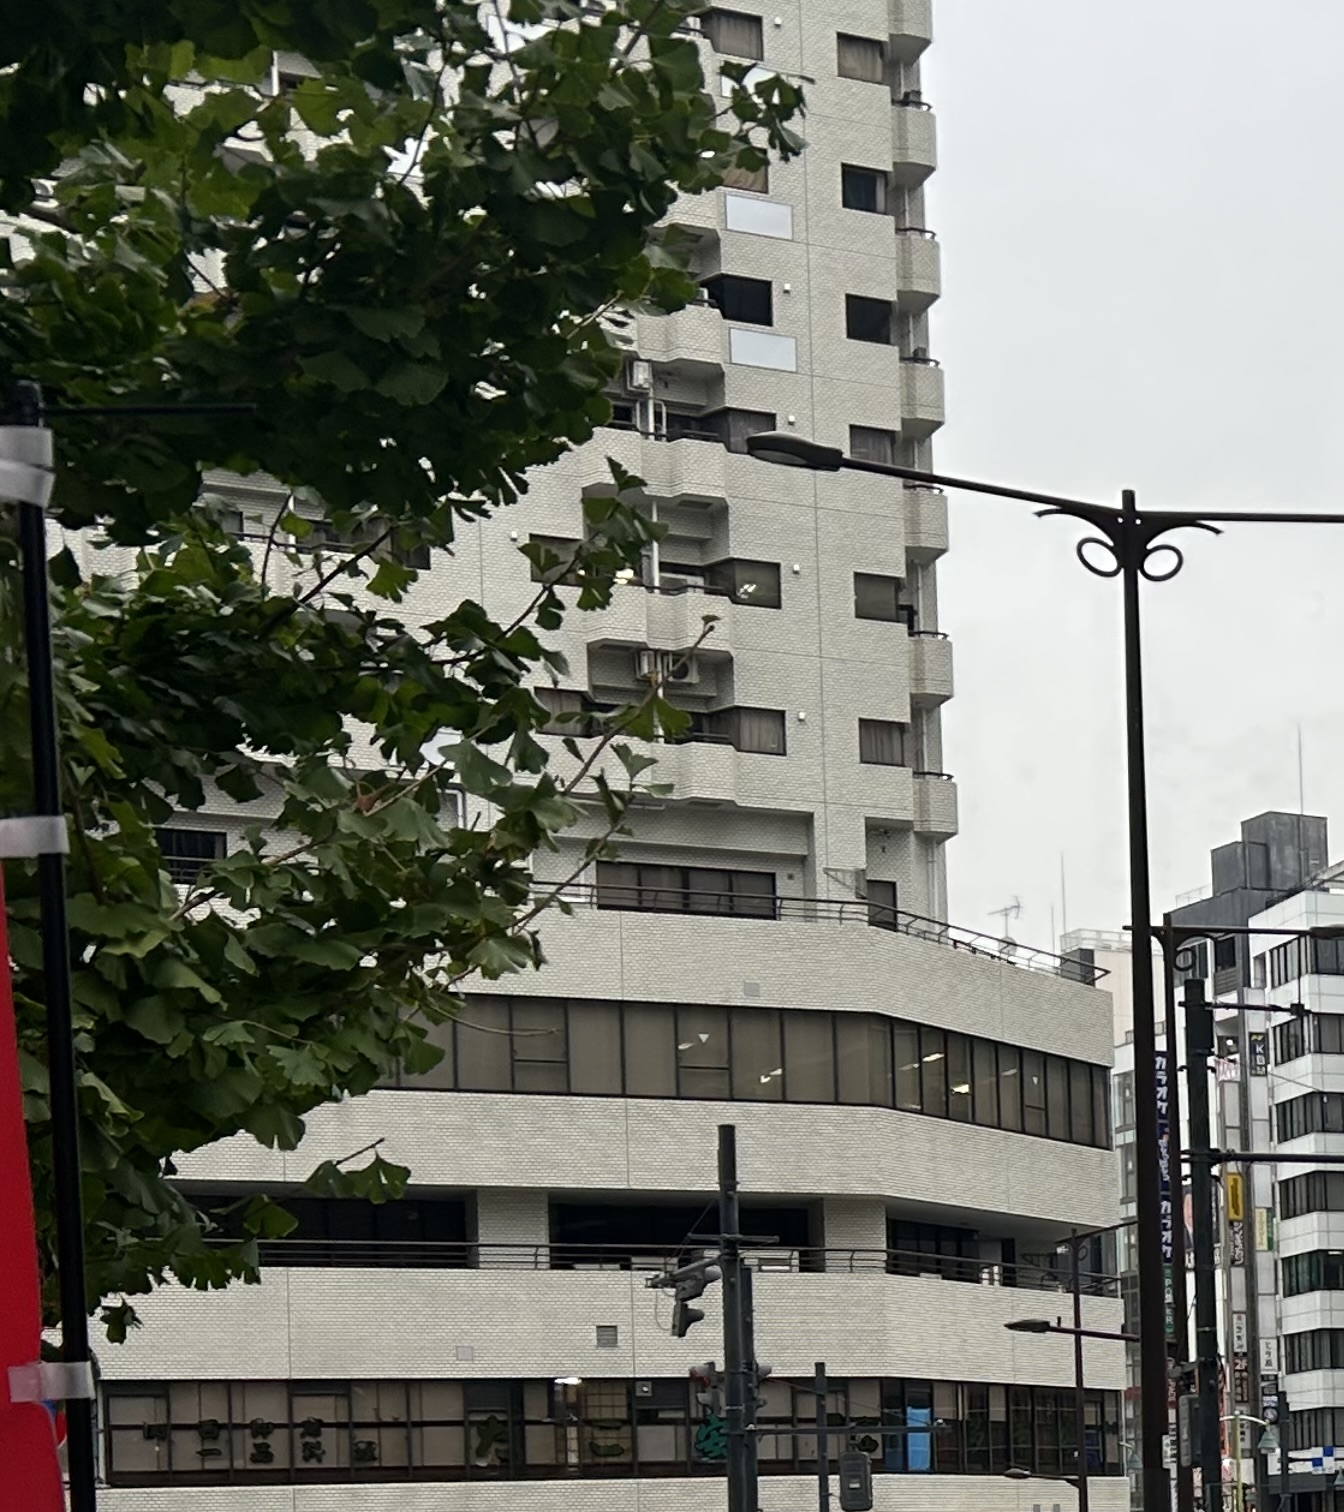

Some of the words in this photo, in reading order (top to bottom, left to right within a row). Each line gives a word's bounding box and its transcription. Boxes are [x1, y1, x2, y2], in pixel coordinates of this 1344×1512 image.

[1155, 1056, 1169, 1115] カラオケ
[1160, 1200, 1173, 1258] カラオケ
